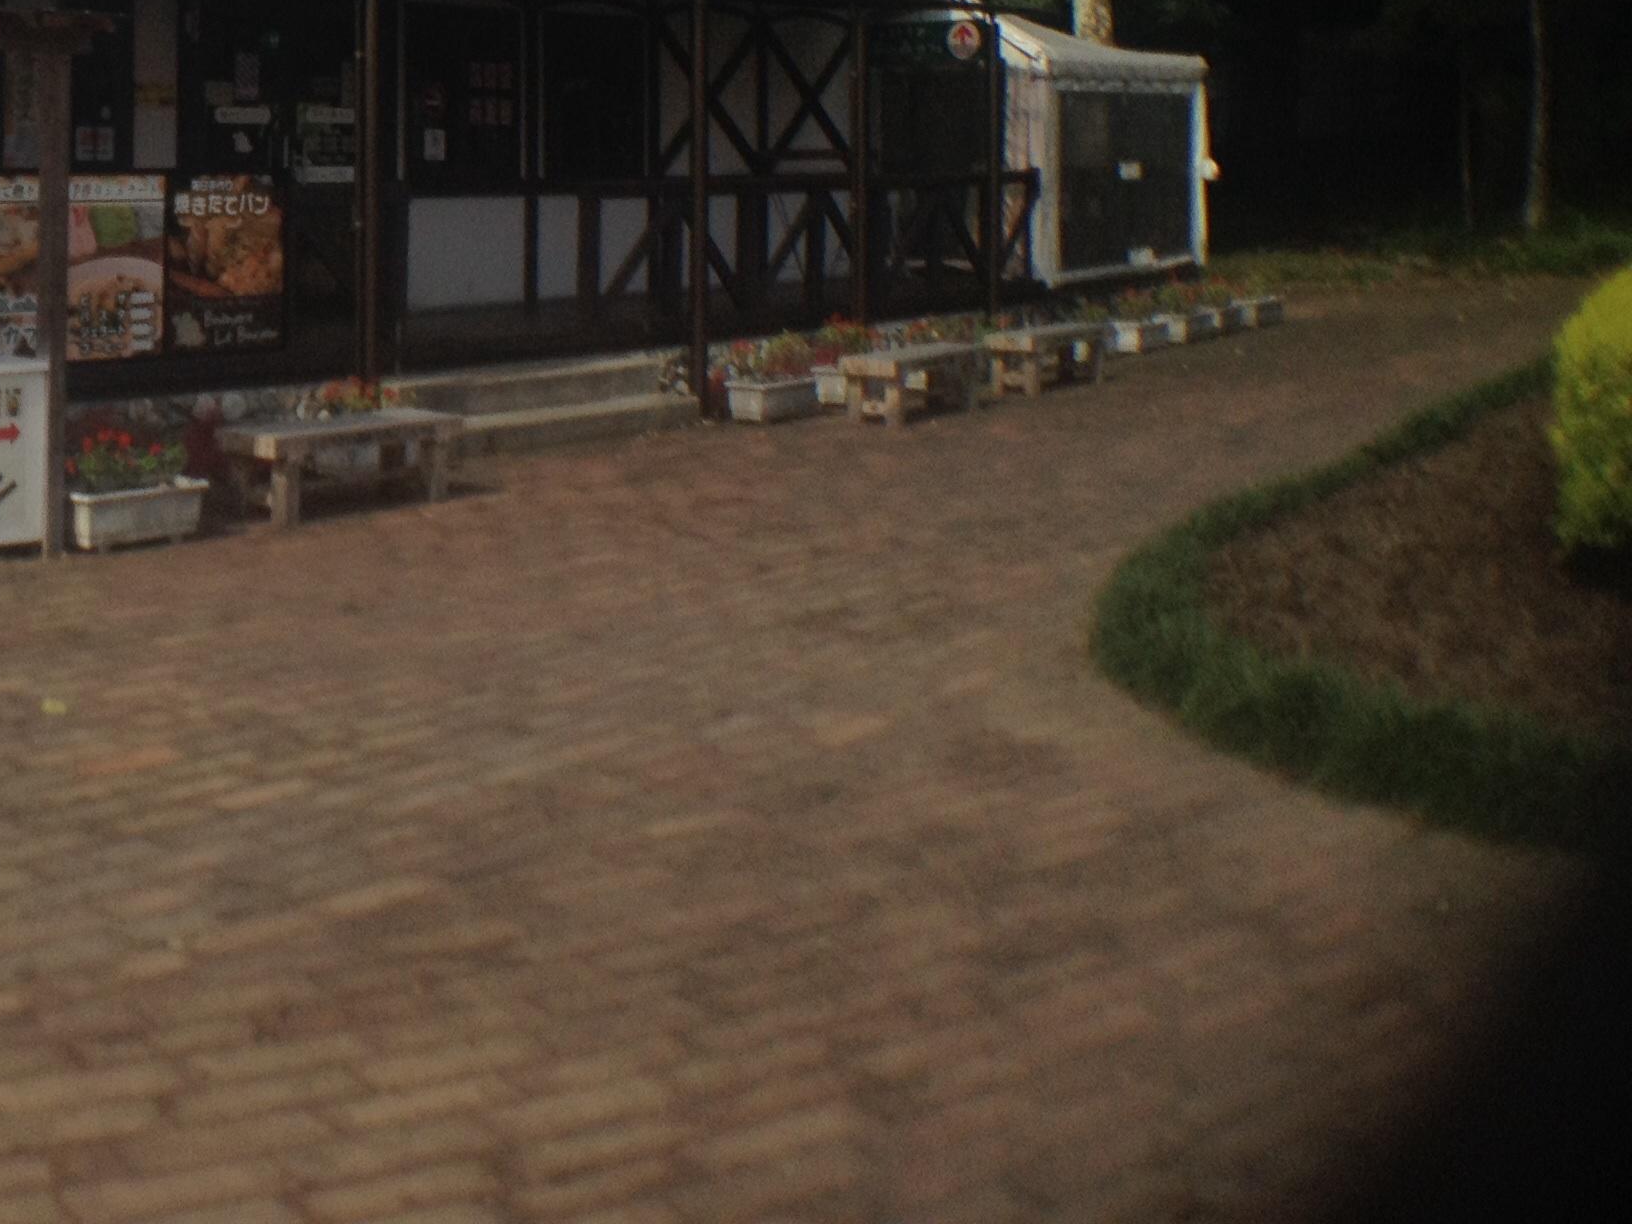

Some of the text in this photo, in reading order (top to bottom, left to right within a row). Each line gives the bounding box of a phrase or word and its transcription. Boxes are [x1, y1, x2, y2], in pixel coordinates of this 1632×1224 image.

[174, 192, 270, 216] 焼きたてパン
